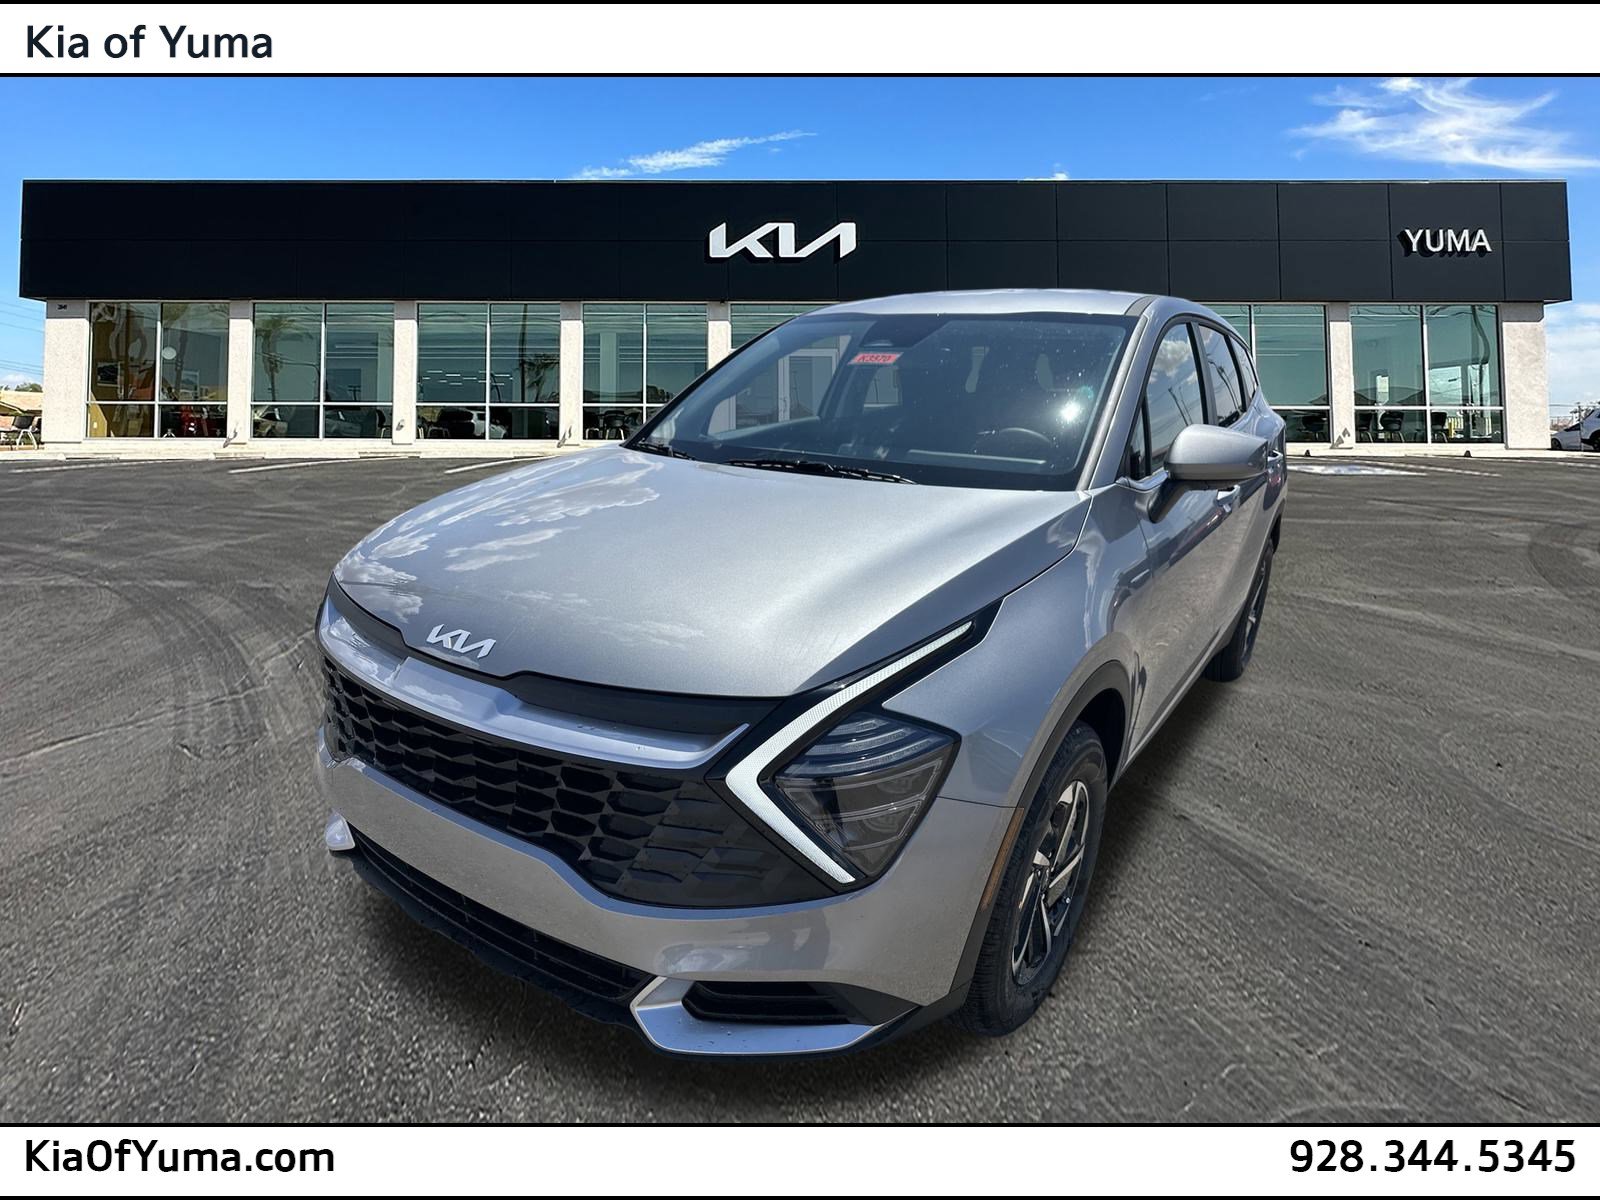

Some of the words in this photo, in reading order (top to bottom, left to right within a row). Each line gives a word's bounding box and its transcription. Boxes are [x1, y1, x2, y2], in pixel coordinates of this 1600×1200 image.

[709, 222, 857, 258] KIA
[1404, 229, 1492, 252] YUMA
[426, 624, 497, 658] KIA
